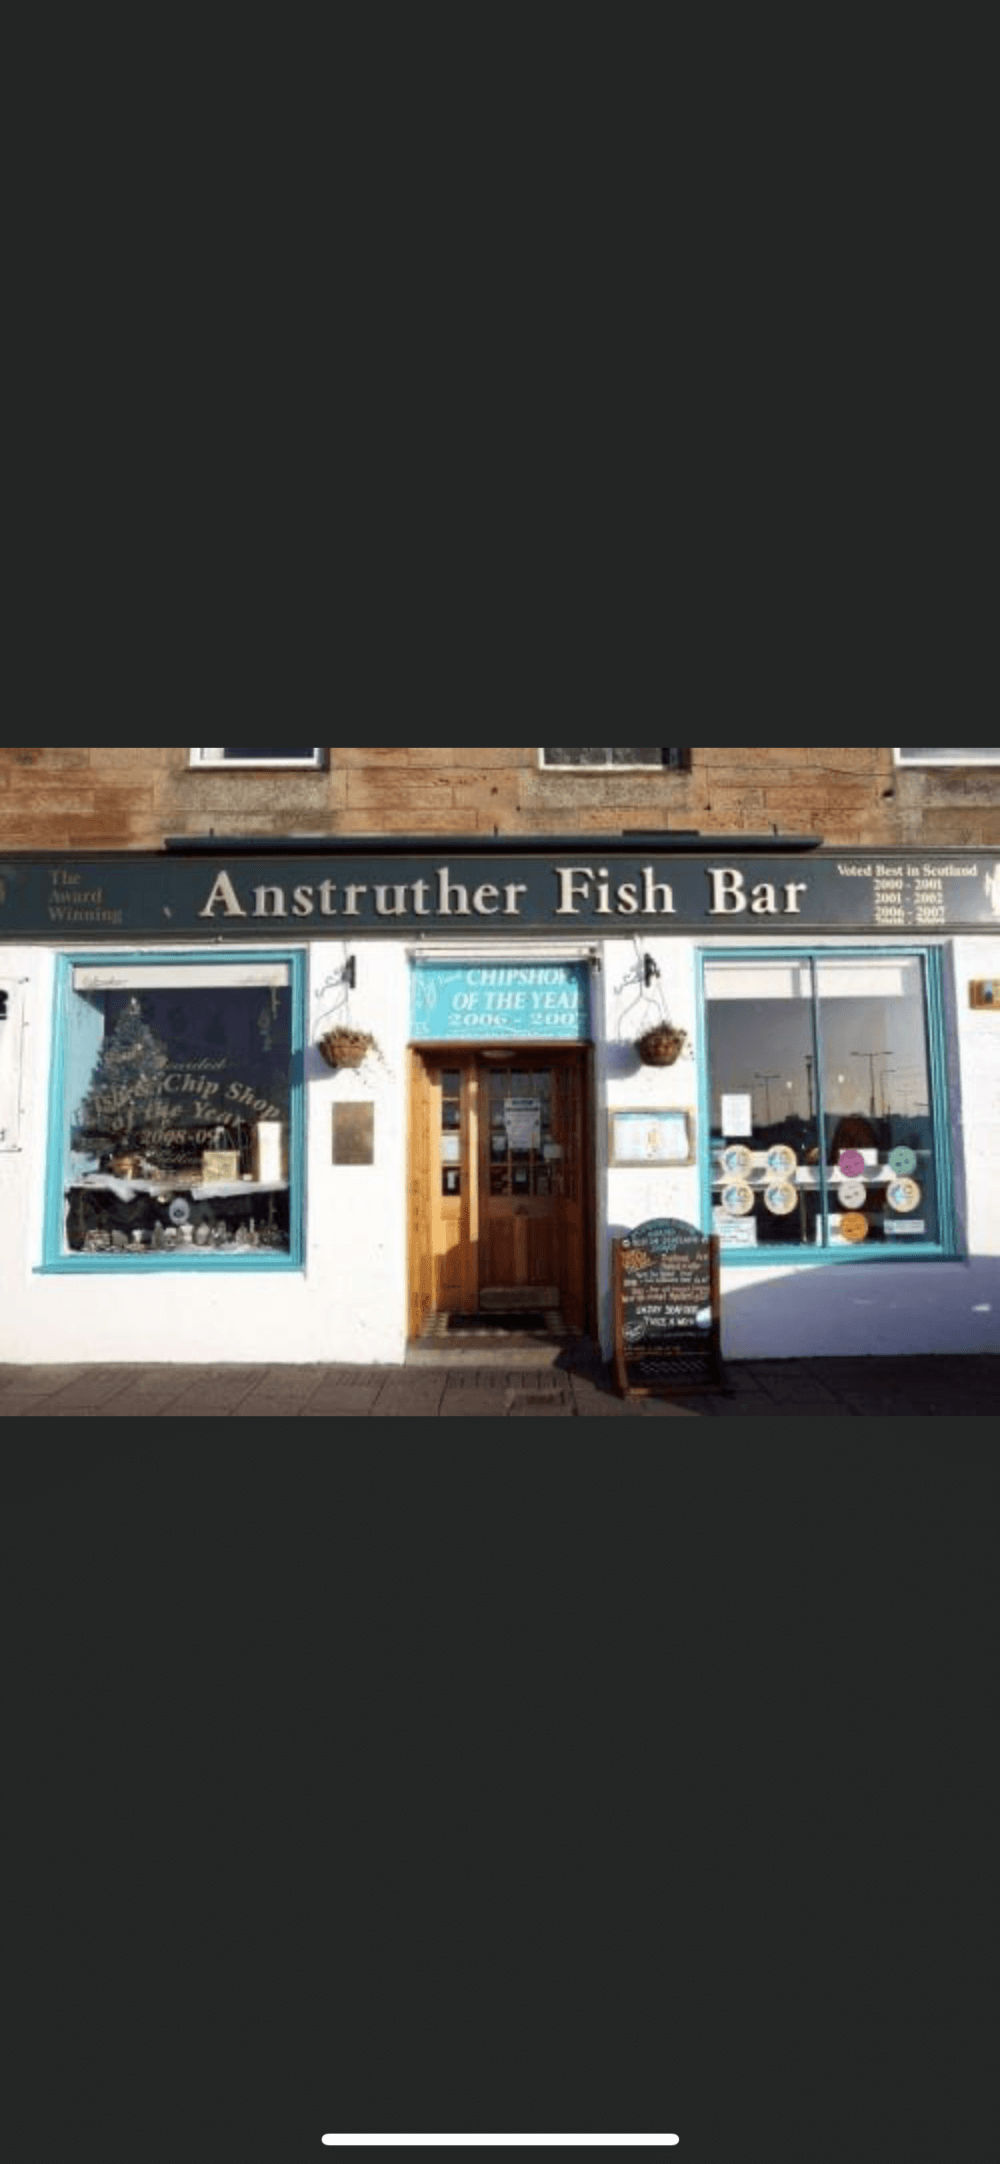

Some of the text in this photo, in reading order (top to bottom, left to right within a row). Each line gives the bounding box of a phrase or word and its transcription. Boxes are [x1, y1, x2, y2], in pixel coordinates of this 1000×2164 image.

[49, 869, 81, 885] The
[837, 864, 978, 876] Voted Best in Scotland
[48, 887, 102, 904] Award
[198, 866, 808, 917] Anstruther Fish Bar
[874, 891, 902, 904] 2001
[48, 906, 122, 924] Winning
[452, 991, 480, 1011] OF
[485, 991, 526, 1010] THE
[448, 1012, 510, 1026] 2006
[162, 1073, 219, 1100] Chip
[225, 1081, 281, 1119] Shop
[145, 1098, 183, 1119] the
[194, 1101, 246, 1126] Year
